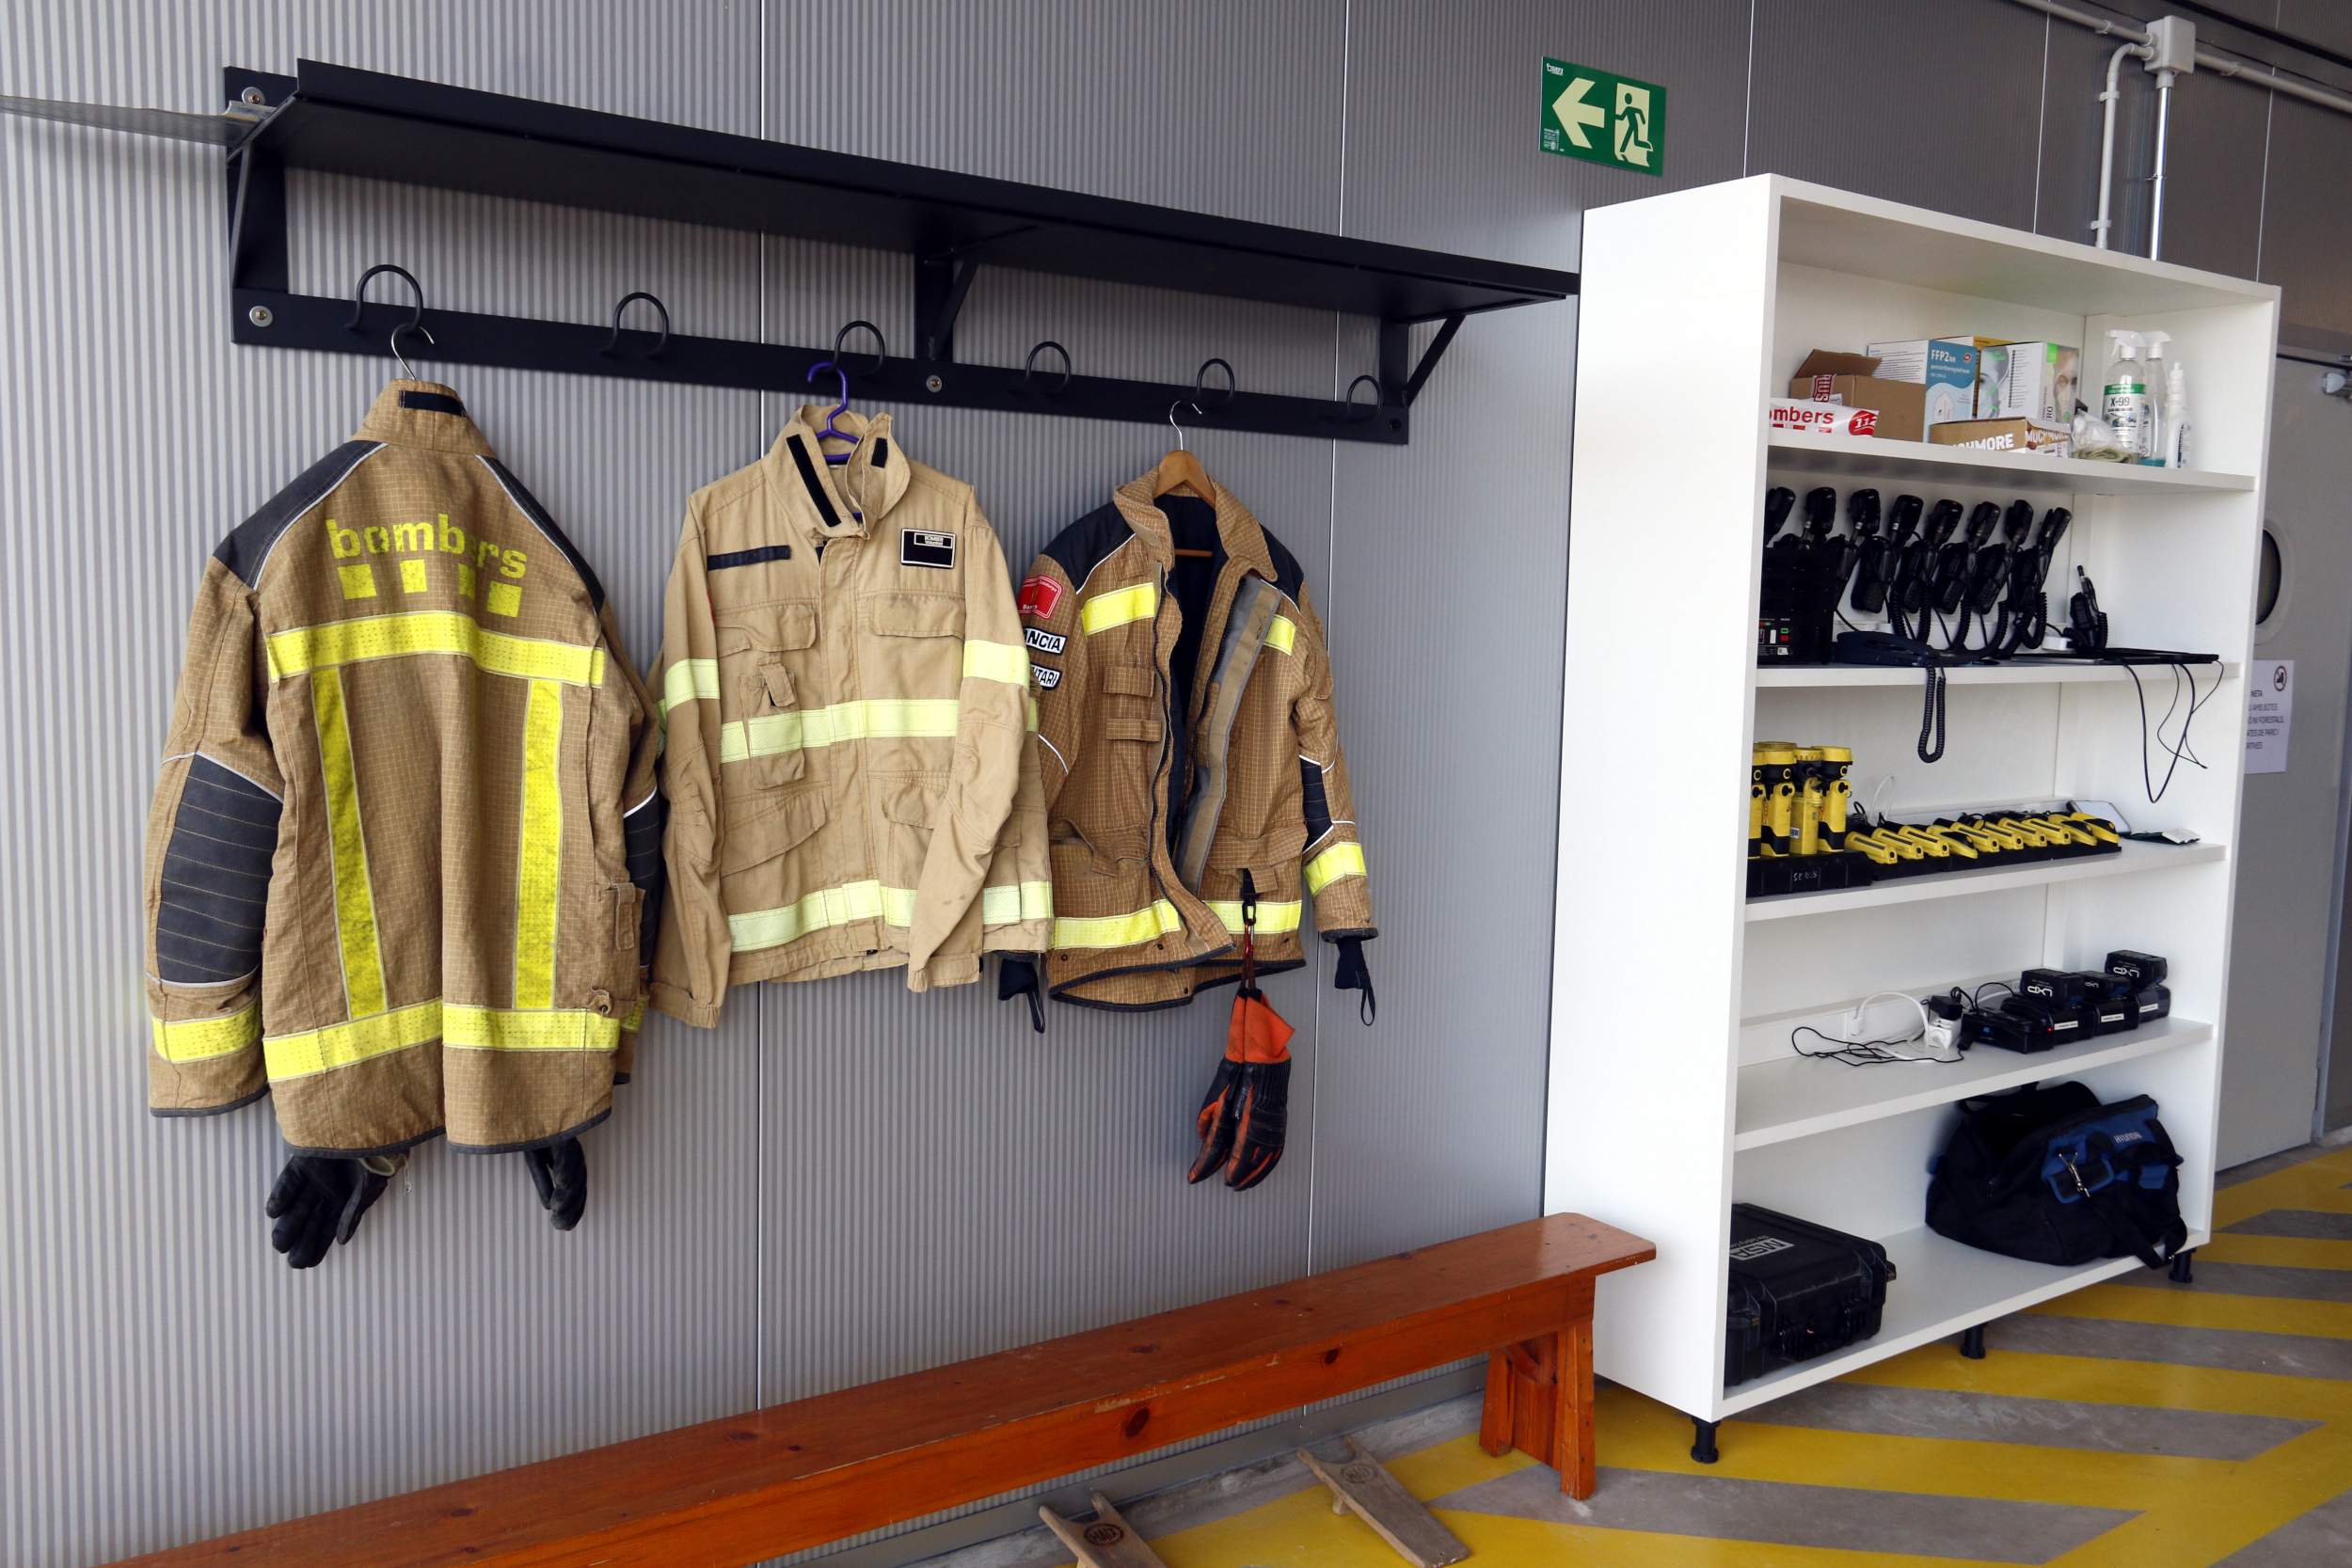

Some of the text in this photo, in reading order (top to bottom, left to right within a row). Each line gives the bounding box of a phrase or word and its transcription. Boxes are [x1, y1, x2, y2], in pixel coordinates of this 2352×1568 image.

[1931, 349, 1949, 362] FFP2
[2110, 396, 2130, 407] X-99
[1730, 1240, 1785, 1258] MSA
